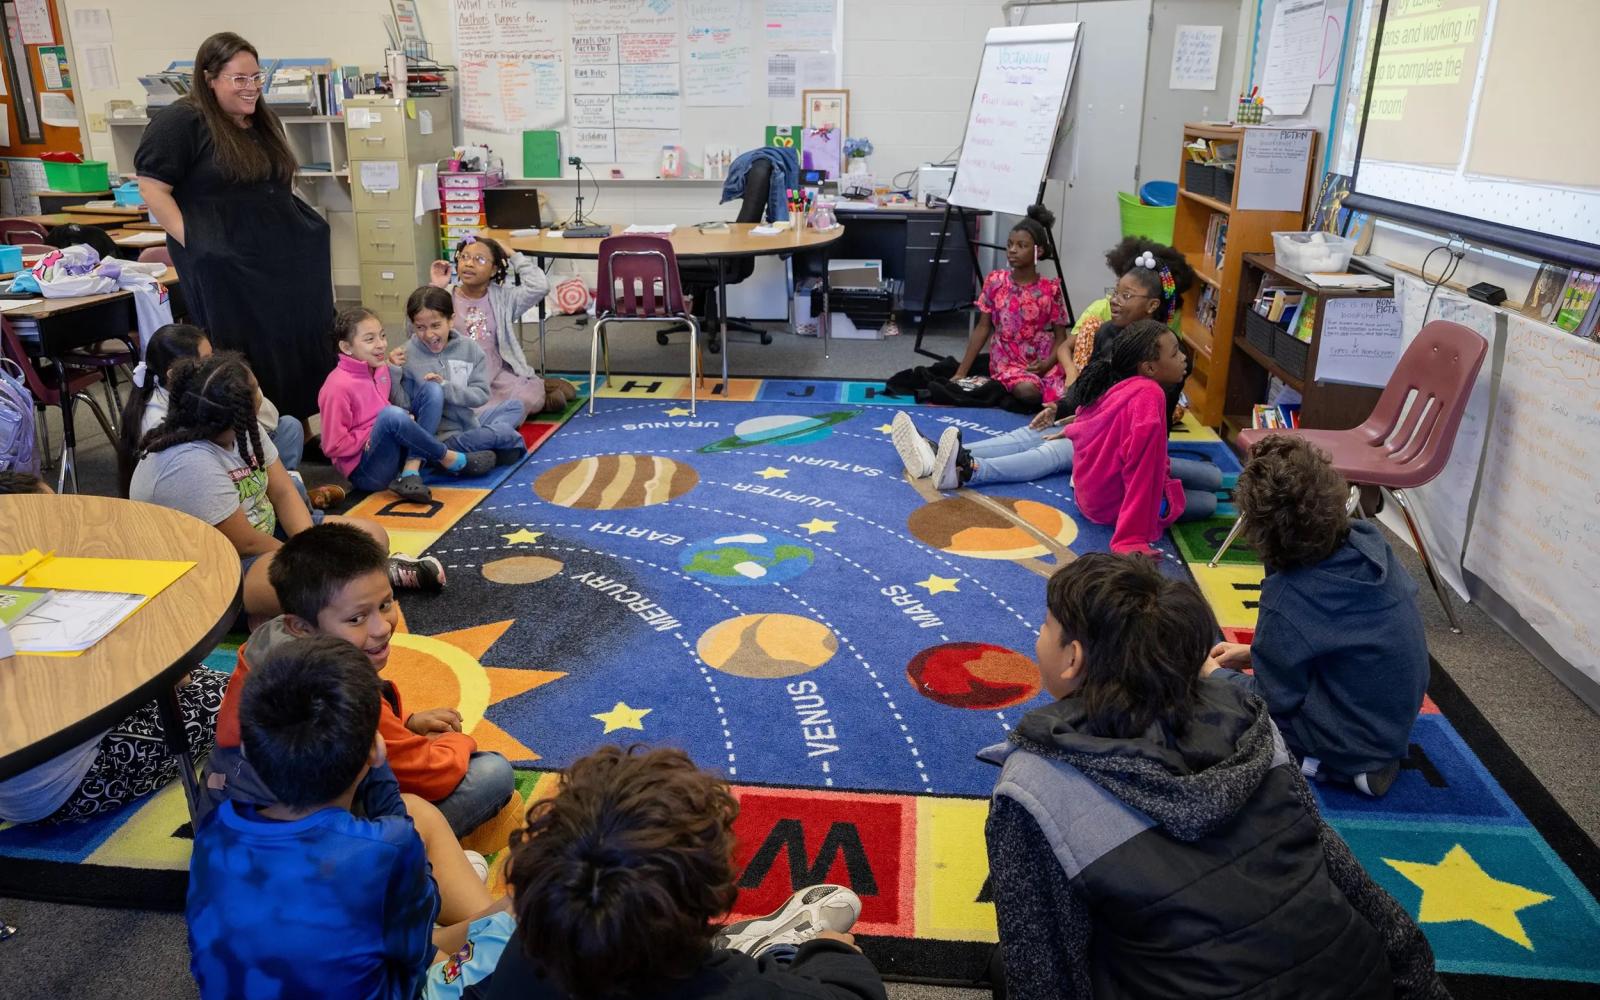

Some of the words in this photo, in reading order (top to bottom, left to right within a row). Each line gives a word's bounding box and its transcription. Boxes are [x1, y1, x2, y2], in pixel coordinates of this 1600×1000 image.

[1401, 23, 1421, 44] and
[1423, 18, 1462, 42] working
[1464, 13, 1477, 36] in
[1387, 63, 1397, 80] to
[1399, 57, 1443, 82] complete
[1445, 55, 1462, 77] the
[1280, 130, 1308, 140] FICTION
[620, 381, 662, 393] H
[622, 421, 720, 431] URANUS
[936, 416, 1009, 437] PTUNE
[787, 454, 883, 477] SATURN
[732, 482, 836, 507] JUPITER
[588, 521, 685, 546] EARTH
[571, 571, 683, 632] MERCURY
[880, 584, 943, 629] MARS
[787, 680, 841, 758] VENUS
[738, 819, 878, 896] W
